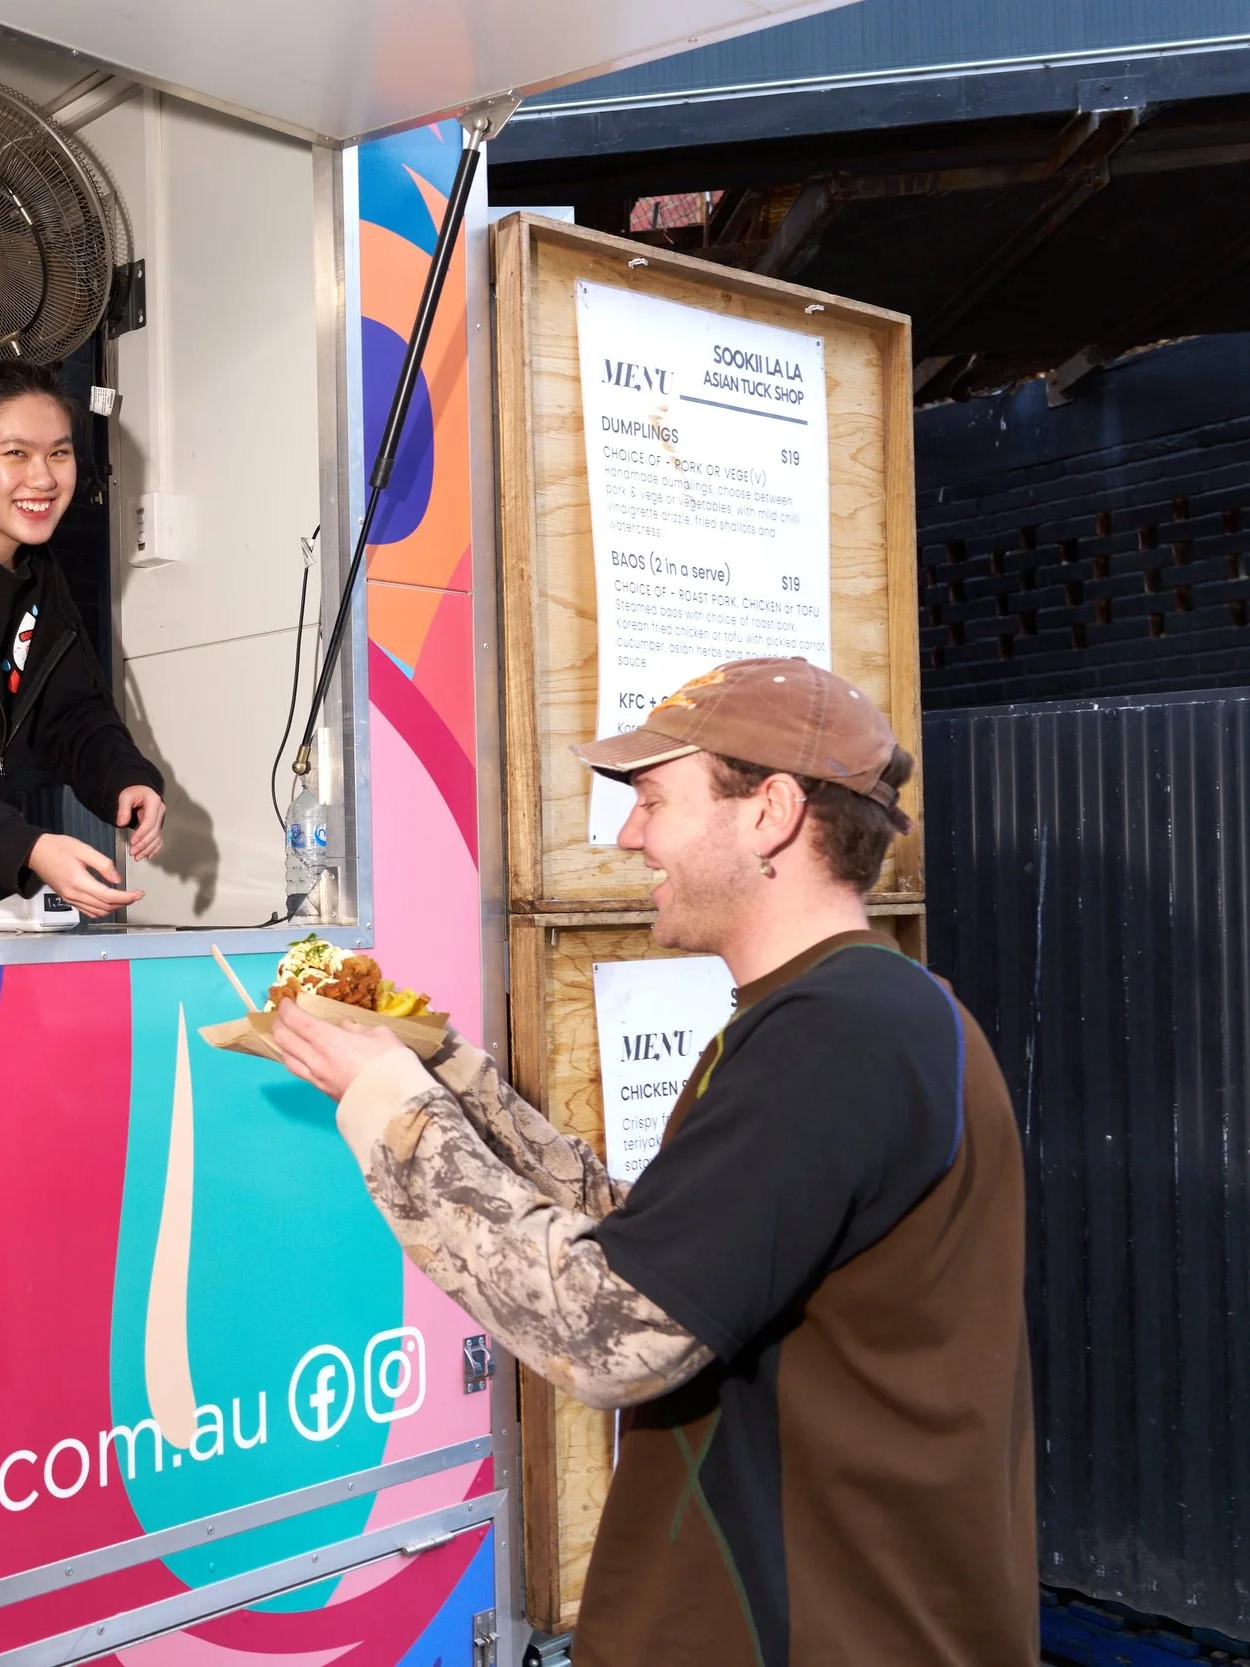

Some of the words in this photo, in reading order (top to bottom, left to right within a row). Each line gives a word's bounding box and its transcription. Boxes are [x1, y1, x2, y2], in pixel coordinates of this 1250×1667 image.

[601, 358, 674, 396] MENU
[713, 344, 762, 374] SOOKII
[766, 356, 783, 378] LA
[786, 360, 803, 383] LA
[703, 370, 739, 392] ASIAN
[740, 378, 771, 400] TUCK
[774, 385, 804, 405] SHOP
[601, 415, 679, 444] DUMPLINGS
[603, 445, 644, 465] CHOICE
[648, 453, 661, 467] OF
[674, 458, 702, 475] PORK
[706, 464, 721, 478] OR
[780, 448, 800, 466] $19
[604, 464, 658, 484] Handmade
[717, 485, 751, 500] choose
[754, 489, 792, 506] between
[606, 484, 627, 497] pork
[641, 491, 662, 505] vege
[665, 495, 675, 505] or
[736, 505, 756, 517] with
[758, 508, 777, 521] mild
[695, 515, 717, 529] fried
[719, 518, 756, 535] shallots
[758, 526, 776, 538] and
[611, 550, 646, 570] BAOS
[650, 551, 662, 576] (2
[666, 558, 677, 575] in
[680, 564, 689, 577] a
[692, 562, 731, 587] serve)
[781, 575, 800, 592] $19
[614, 579, 651, 597] CHOICE
[654, 585, 667, 598] OF
[678, 589, 708, 605] ROAST
[741, 597, 781, 613] CHICKEN
[784, 605, 793, 615] or
[797, 604, 819, 618] TOFU
[616, 598, 658, 616] Steamed
[660, 605, 683, 619] baos
[686, 610, 704, 621] with
[706, 611, 737, 626] choice
[740, 615, 749, 627] of
[751, 617, 774, 630] roast
[616, 617, 649, 632] Korean
[651, 621, 672, 635] fried
[675, 625, 710, 640] chicken
[712, 631, 722, 641] or
[724, 631, 743, 643] tofu
[746, 633, 764, 645] with
[766, 636, 797, 650] pickled
[618, 655, 647, 668] sauce
[697, 646, 722, 659] herbs
[724, 649, 743, 660] and
[619, 692, 645, 710] KFC
[620, 1030, 694, 1062] MENU
[620, 1080, 678, 1101] CHICKEN
[622, 1114, 659, 1133] Crispy
